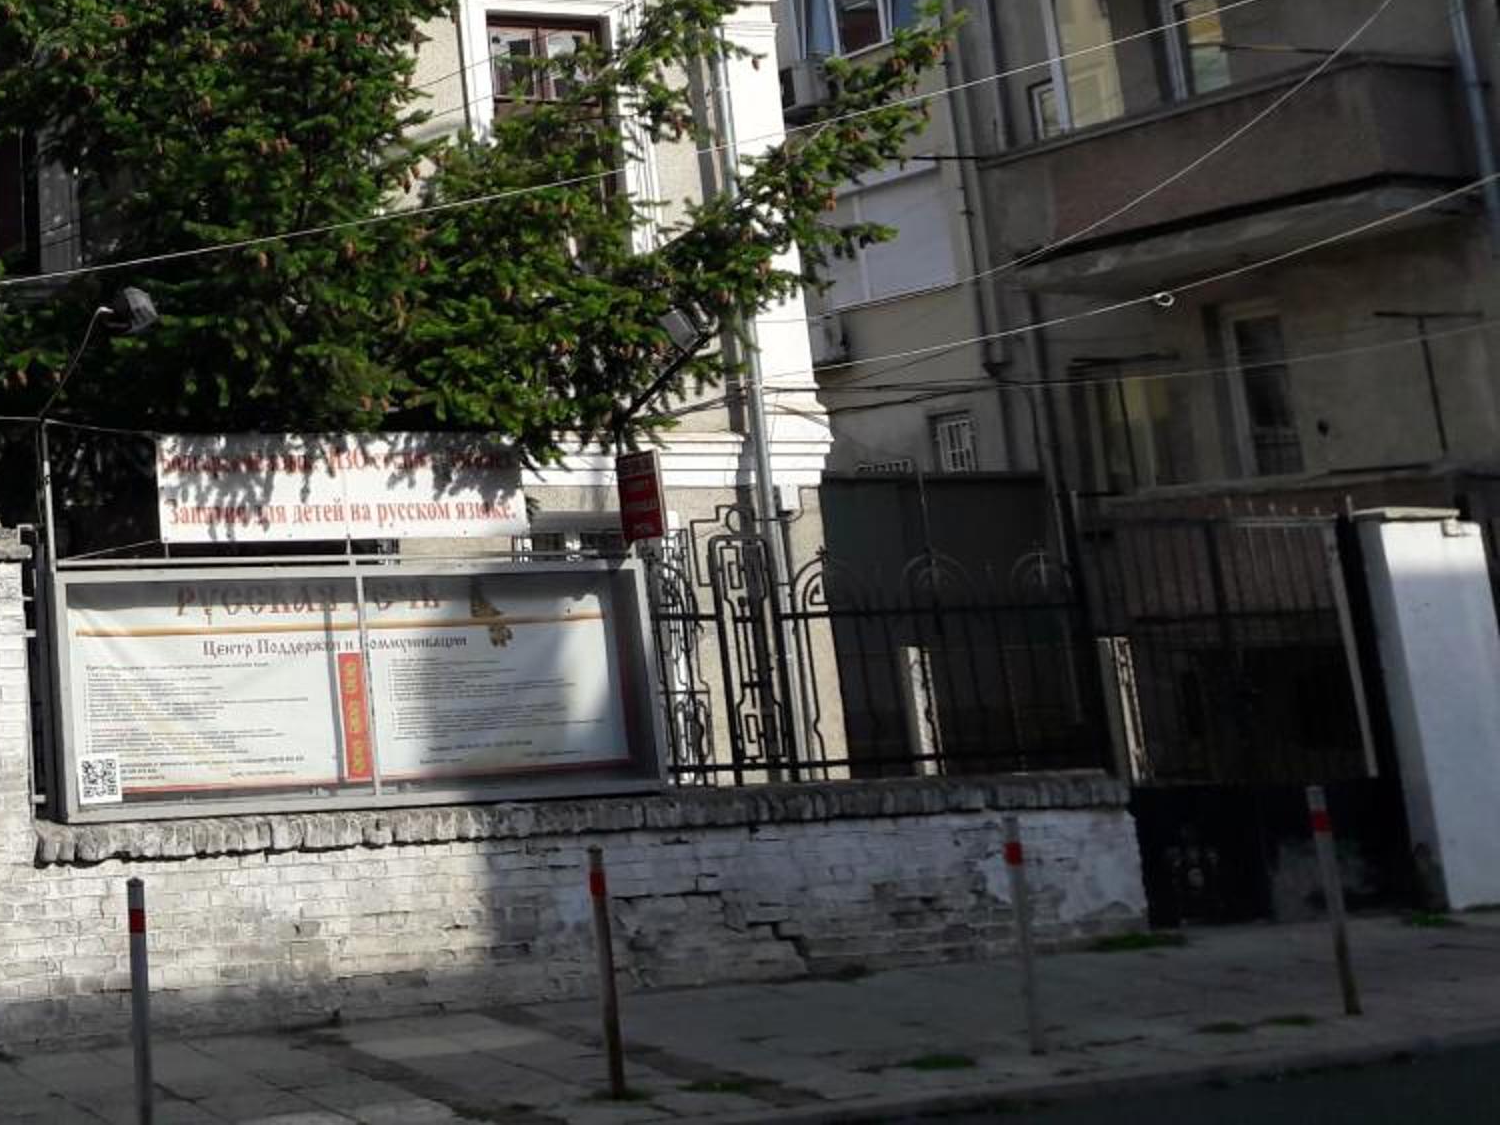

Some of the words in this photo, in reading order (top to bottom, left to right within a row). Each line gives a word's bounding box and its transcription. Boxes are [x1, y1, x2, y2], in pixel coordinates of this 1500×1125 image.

[292, 497, 345, 525] детей
[350, 502, 372, 521] на
[377, 501, 451, 528] русском
[203, 640, 253, 660] Центр
